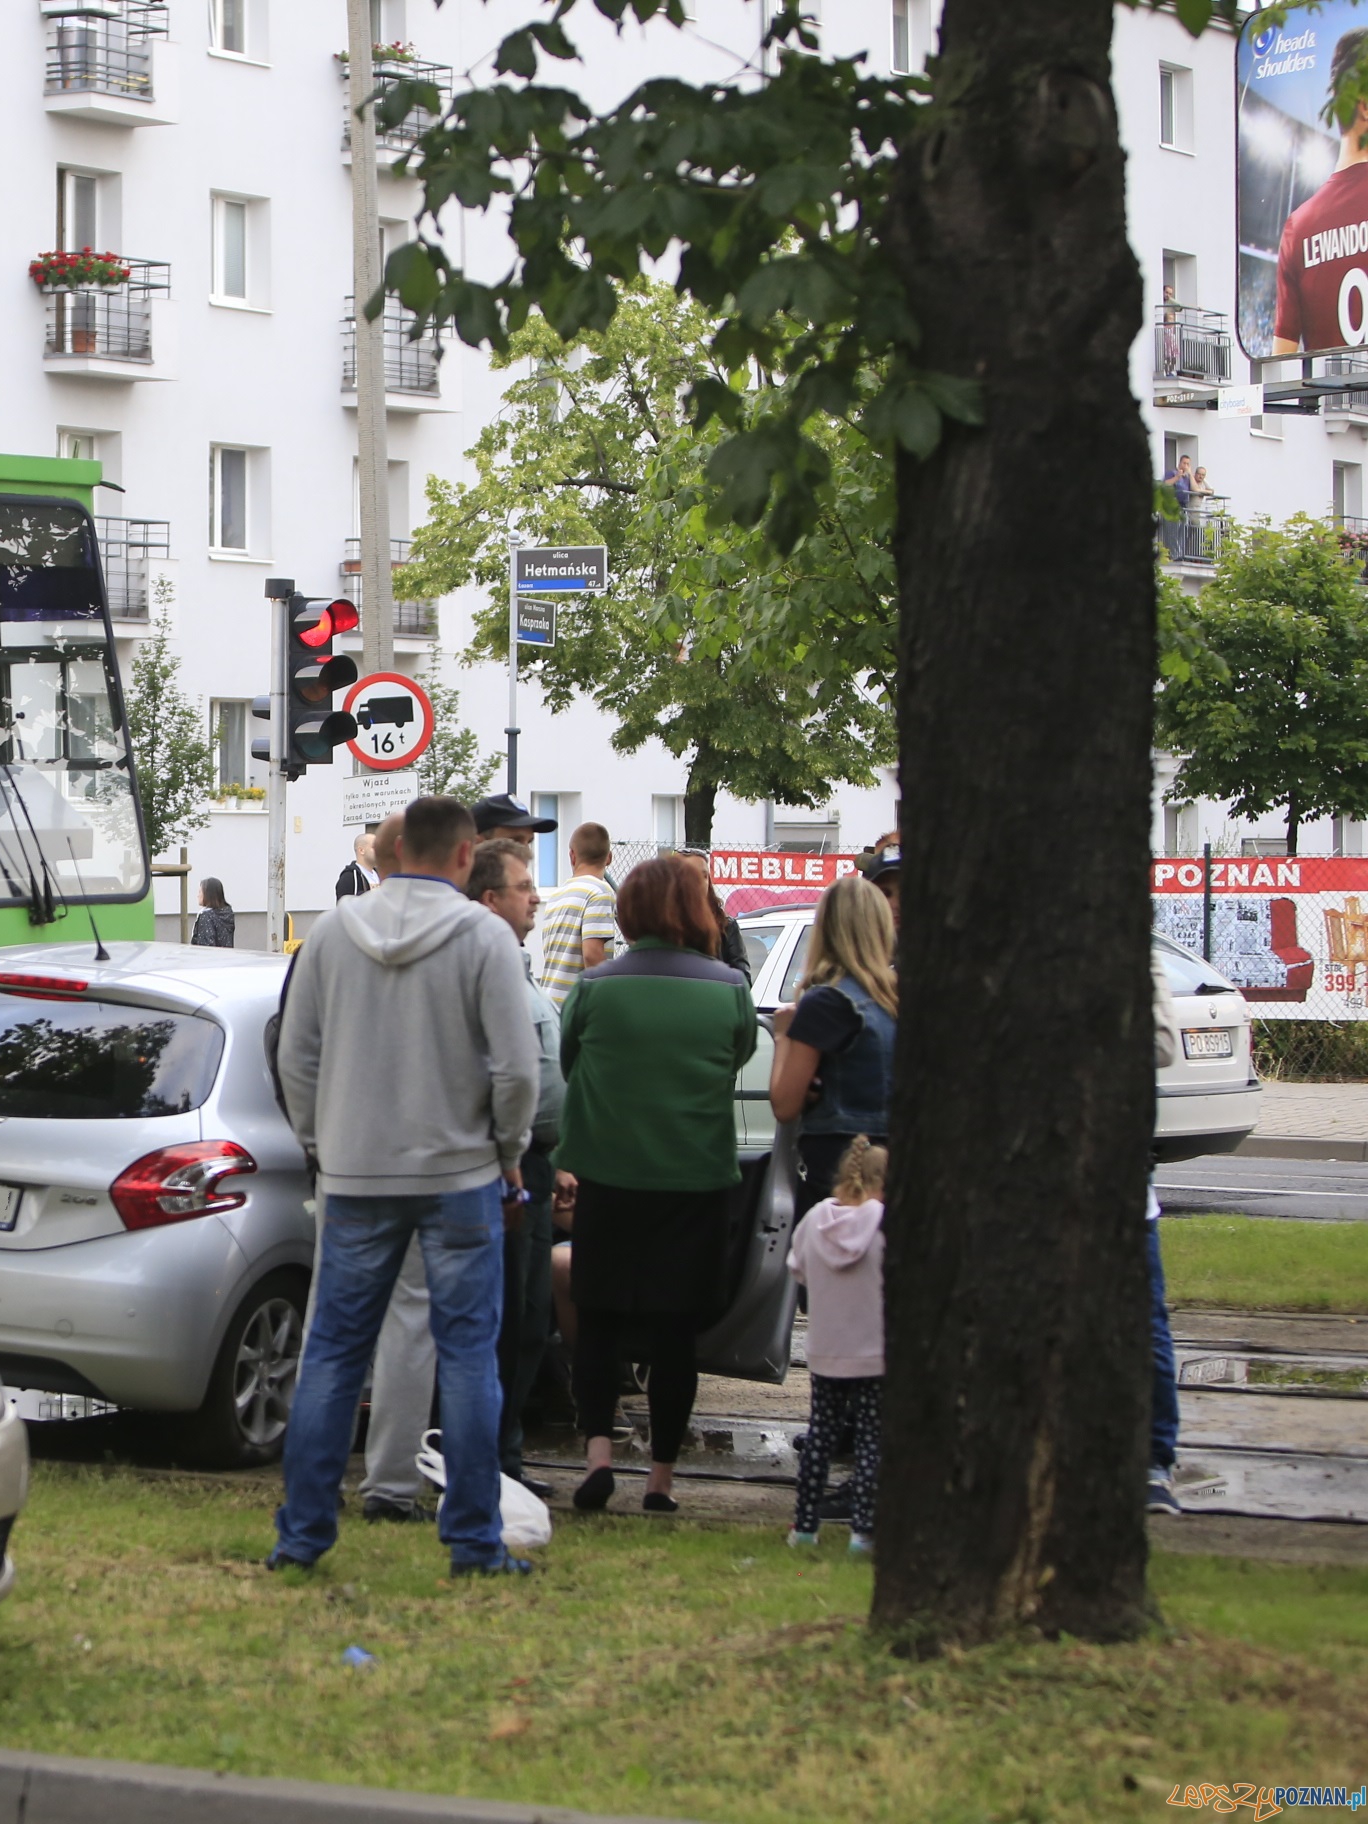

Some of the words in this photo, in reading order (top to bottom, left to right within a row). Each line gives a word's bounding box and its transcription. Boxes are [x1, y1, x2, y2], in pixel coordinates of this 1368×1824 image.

[1255, 52, 1317, 80] shoulders
[1303, 220, 1368, 269] LEWANDO
[1219, 397, 1246, 411] cityboard
[525, 562, 597, 577] Hetmańska
[519, 613, 550, 631] Kasprzaka
[371, 732, 394, 754] 16
[399, 732, 405, 744] t
[363, 777, 390, 788] Wjazd
[345, 793, 359, 801] tylko
[374, 788, 412, 797] warunkach
[390, 799, 408, 807] przez
[713, 856, 824, 880] MEBLE
[1154, 858, 1301, 887] POZNAŃ
[1190, 1034, 1203, 1052] PO
